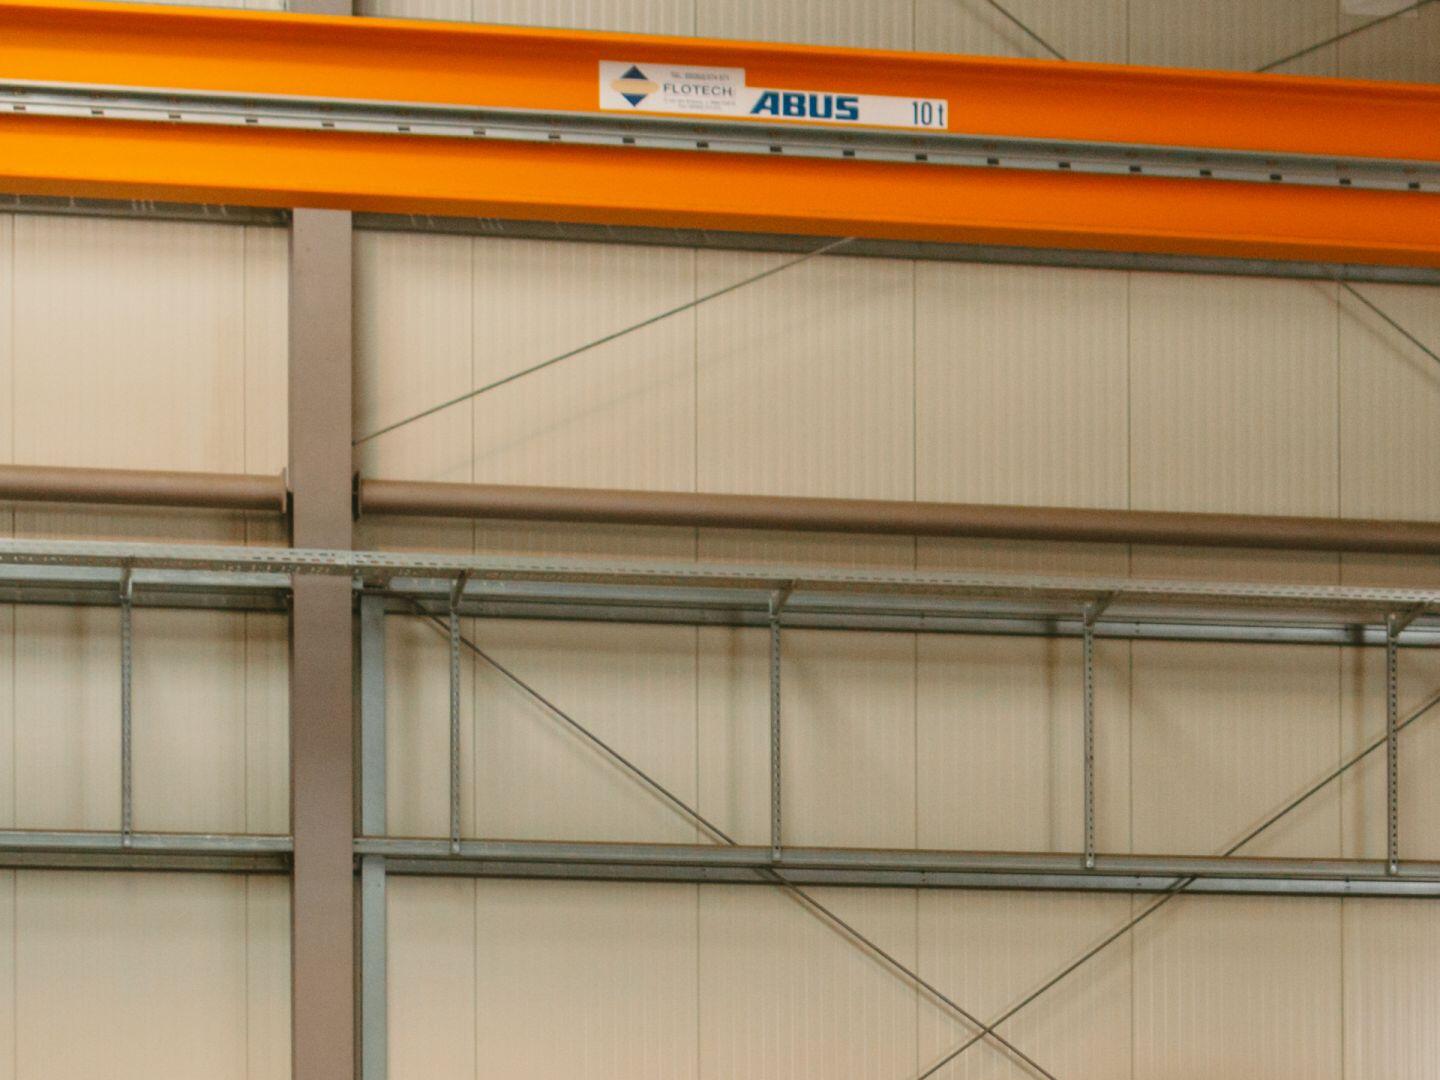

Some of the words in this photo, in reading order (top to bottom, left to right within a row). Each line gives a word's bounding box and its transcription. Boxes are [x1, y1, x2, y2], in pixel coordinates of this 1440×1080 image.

[662, 82, 733, 97] FLOTECH
[750, 91, 859, 120] ABUS
[911, 100, 932, 126] 10
